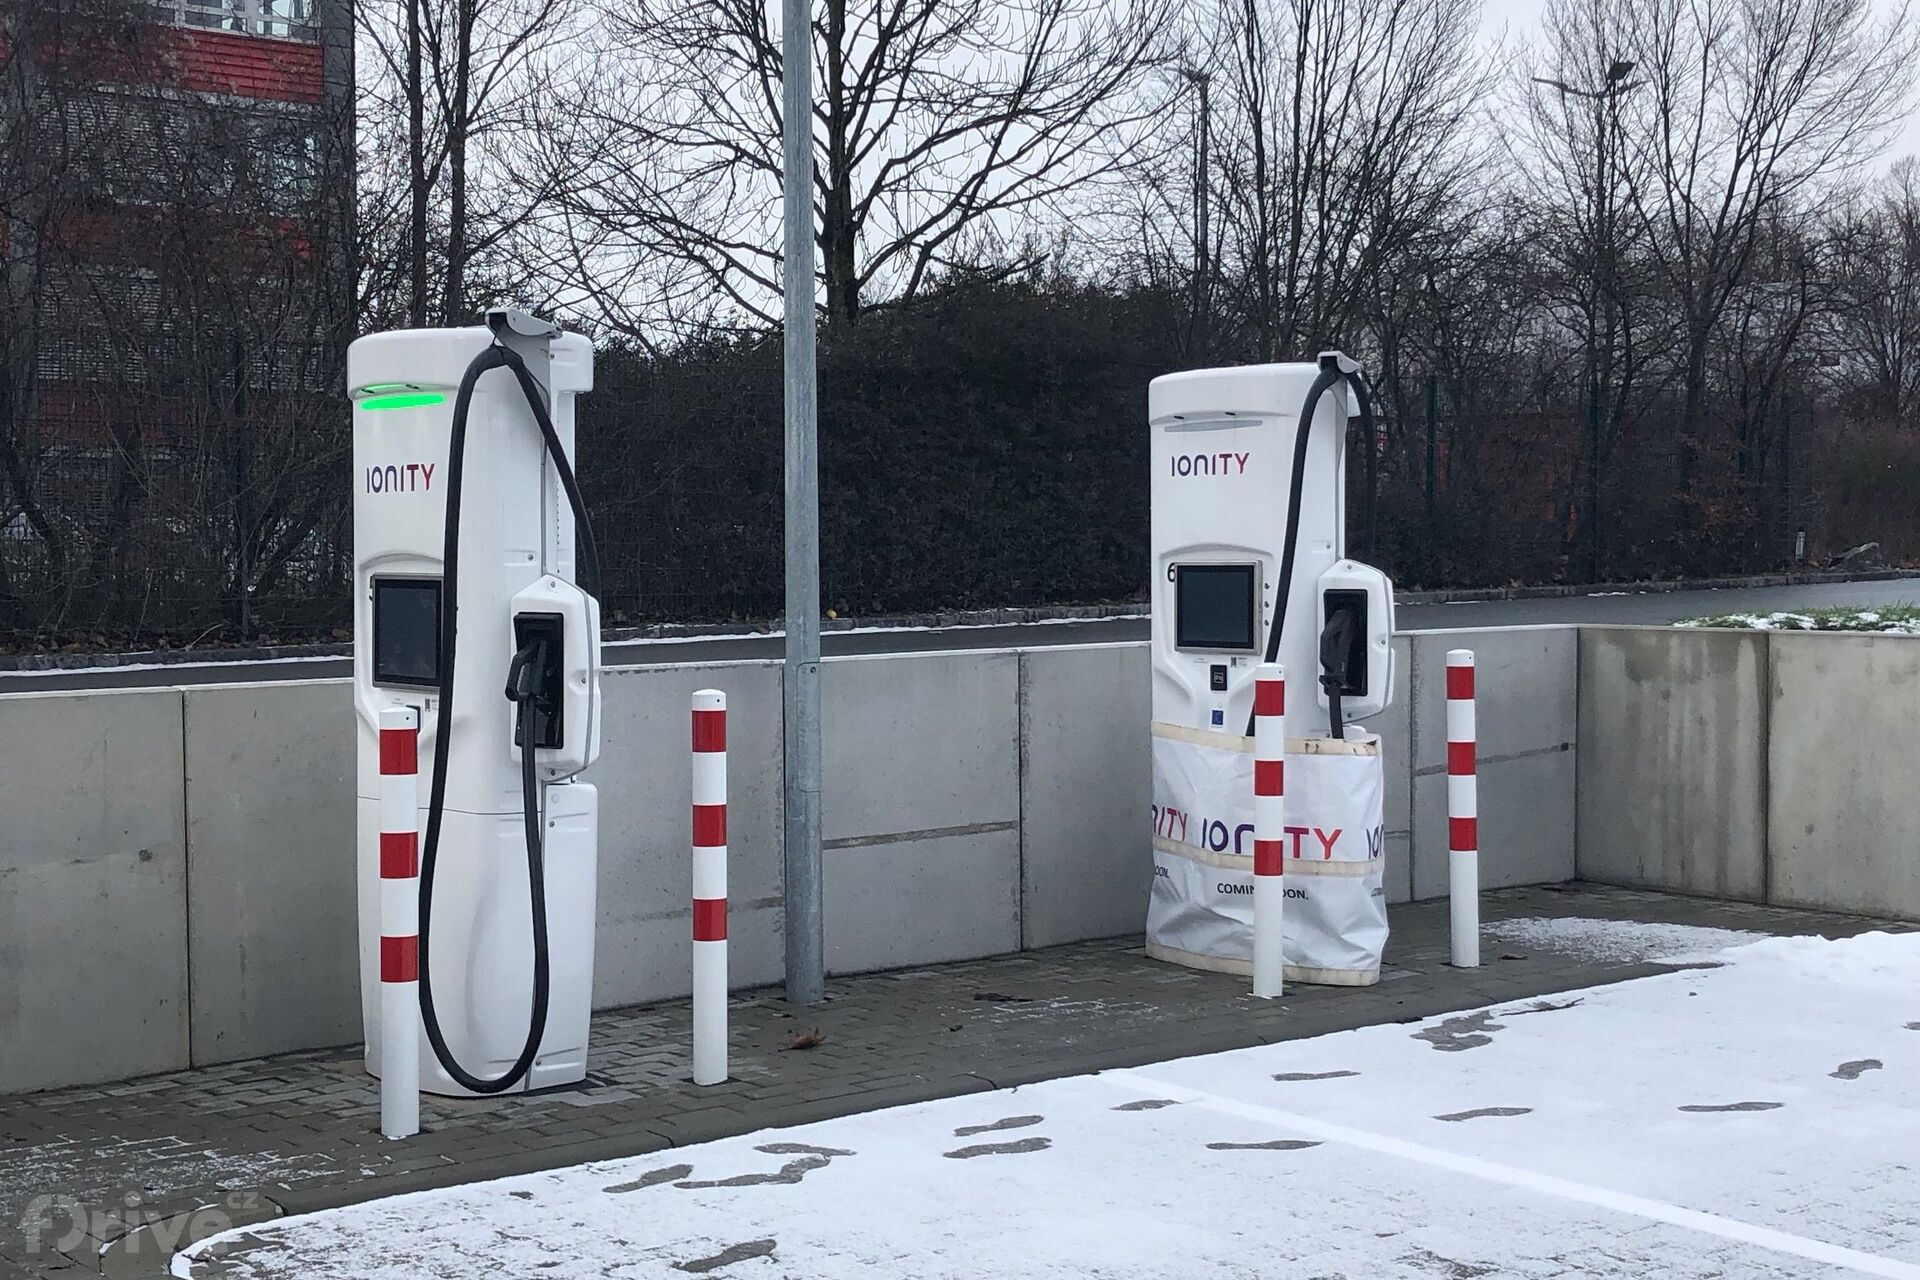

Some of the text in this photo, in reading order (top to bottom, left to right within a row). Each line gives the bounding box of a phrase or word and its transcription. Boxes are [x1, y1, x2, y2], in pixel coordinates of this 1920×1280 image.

[366, 463, 435, 494] IONITY
[1171, 452, 1249, 477] IONITY
[1201, 817, 1343, 860] IONTY
